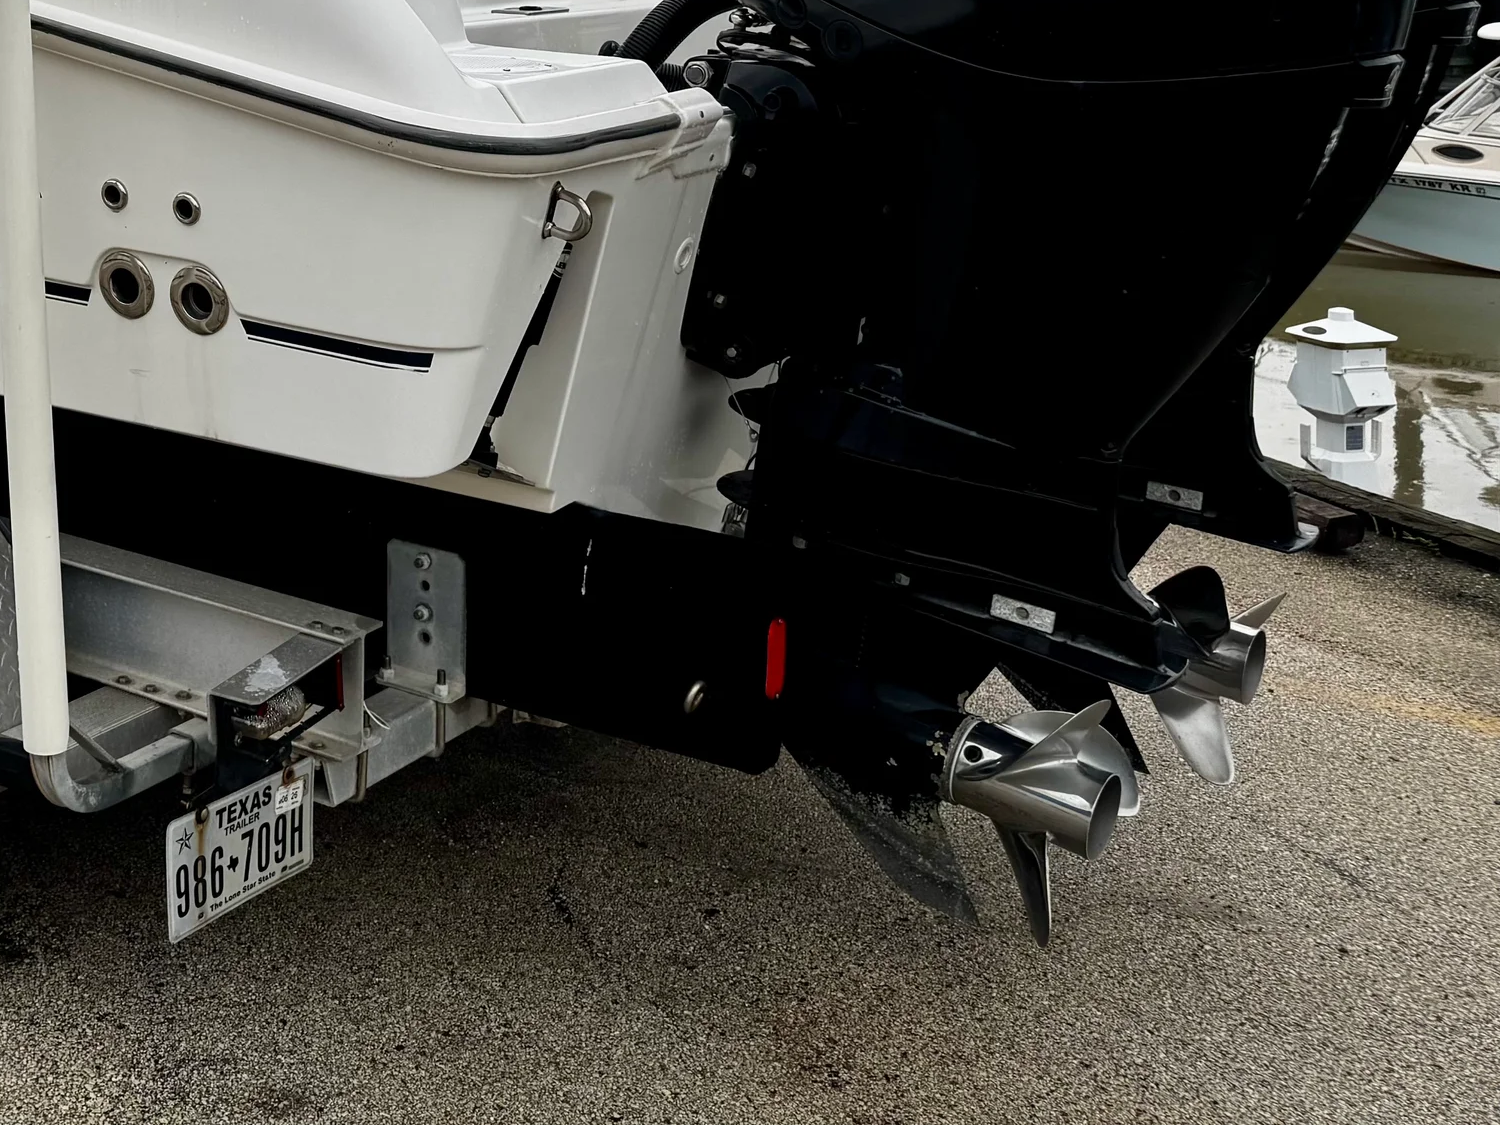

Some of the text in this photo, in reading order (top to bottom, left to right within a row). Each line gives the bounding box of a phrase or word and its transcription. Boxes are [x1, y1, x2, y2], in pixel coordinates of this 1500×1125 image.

[1449, 183, 1472, 192] KR
[215, 785, 272, 829] TEXAS
[223, 811, 260, 836] TRAILER
[210, 871, 276, 912] The Lone Star State
